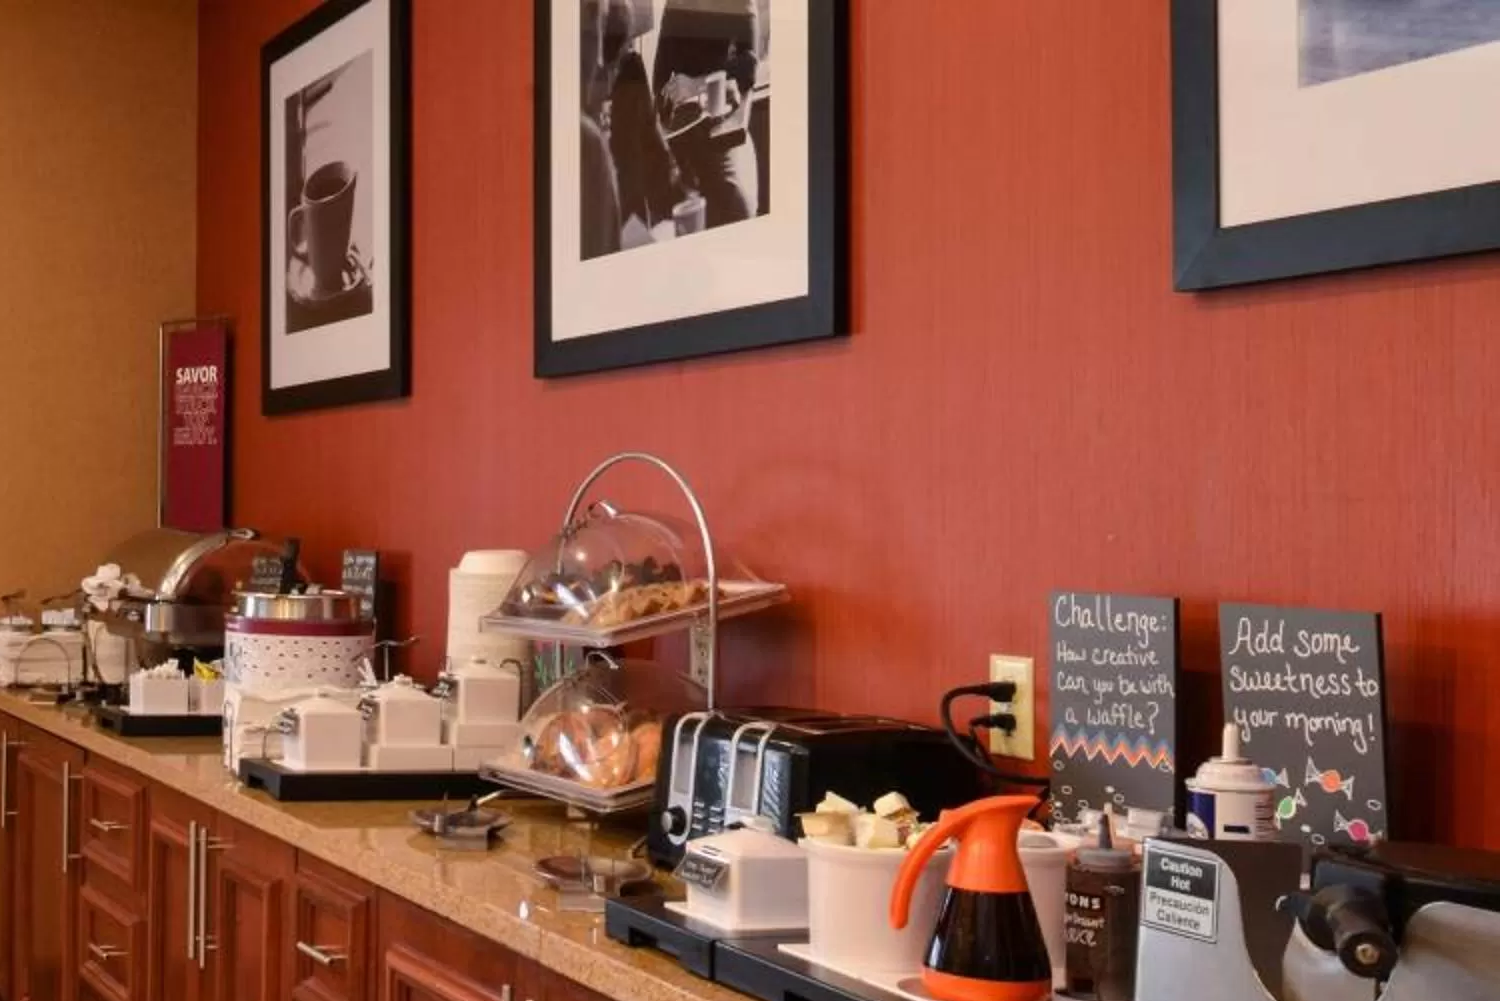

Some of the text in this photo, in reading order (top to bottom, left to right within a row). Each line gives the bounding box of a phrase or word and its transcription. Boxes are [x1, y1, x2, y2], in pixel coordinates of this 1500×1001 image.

[175, 365, 218, 385] SAVOR
[1055, 592, 1167, 649] Challenge:
[1056, 639, 1160, 667] How creative
[1228, 617, 1360, 664] Add some
[1093, 677, 1115, 705] you
[1117, 674, 1138, 696] be
[1140, 672, 1176, 699] with
[1355, 666, 1380, 697] to
[1064, 705, 1079, 725] a
[1234, 706, 1376, 755] your morning!
[1160, 857, 1203, 878] Caution
[1171, 876, 1191, 892] Hot
